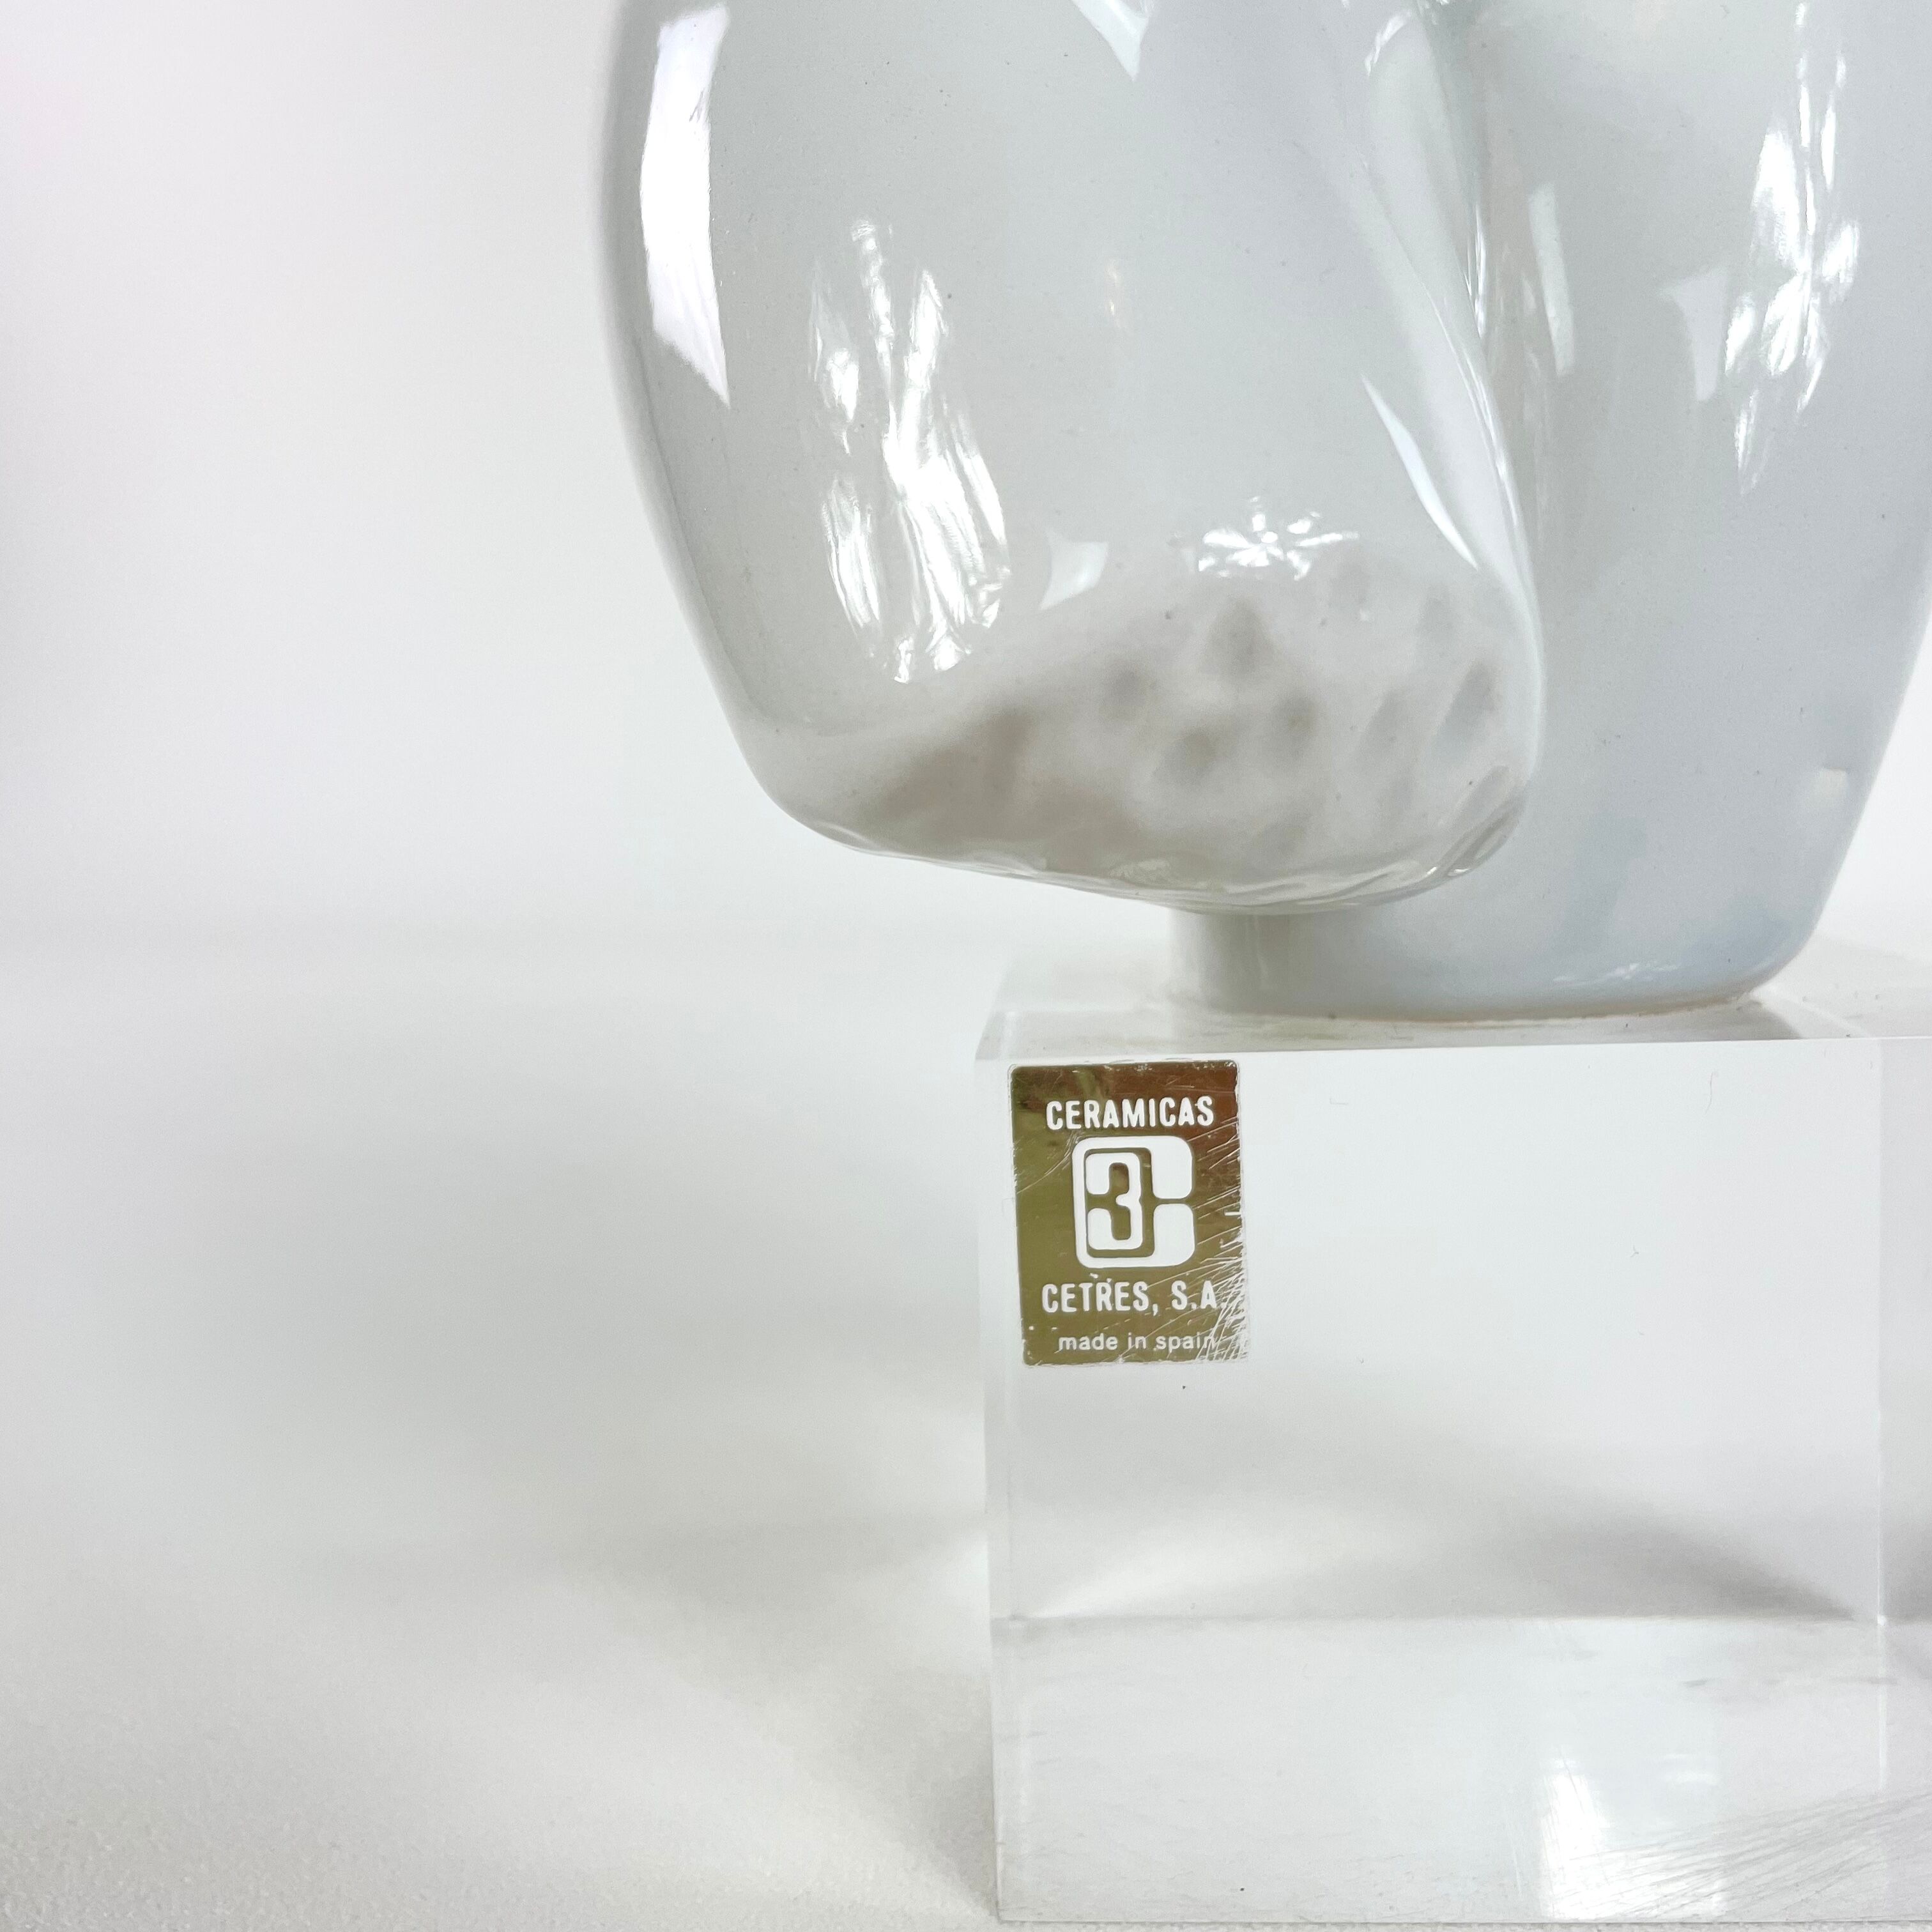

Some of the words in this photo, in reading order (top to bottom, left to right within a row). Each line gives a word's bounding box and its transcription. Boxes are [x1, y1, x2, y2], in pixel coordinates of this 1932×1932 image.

[1046, 1096, 1214, 1130] CERAMICAS
[1041, 1280, 1159, 1316] CETRES,
[1058, 1333, 1118, 1351] made
[1128, 1332, 1147, 1350] in
[1155, 1331, 1216, 1354] spain
